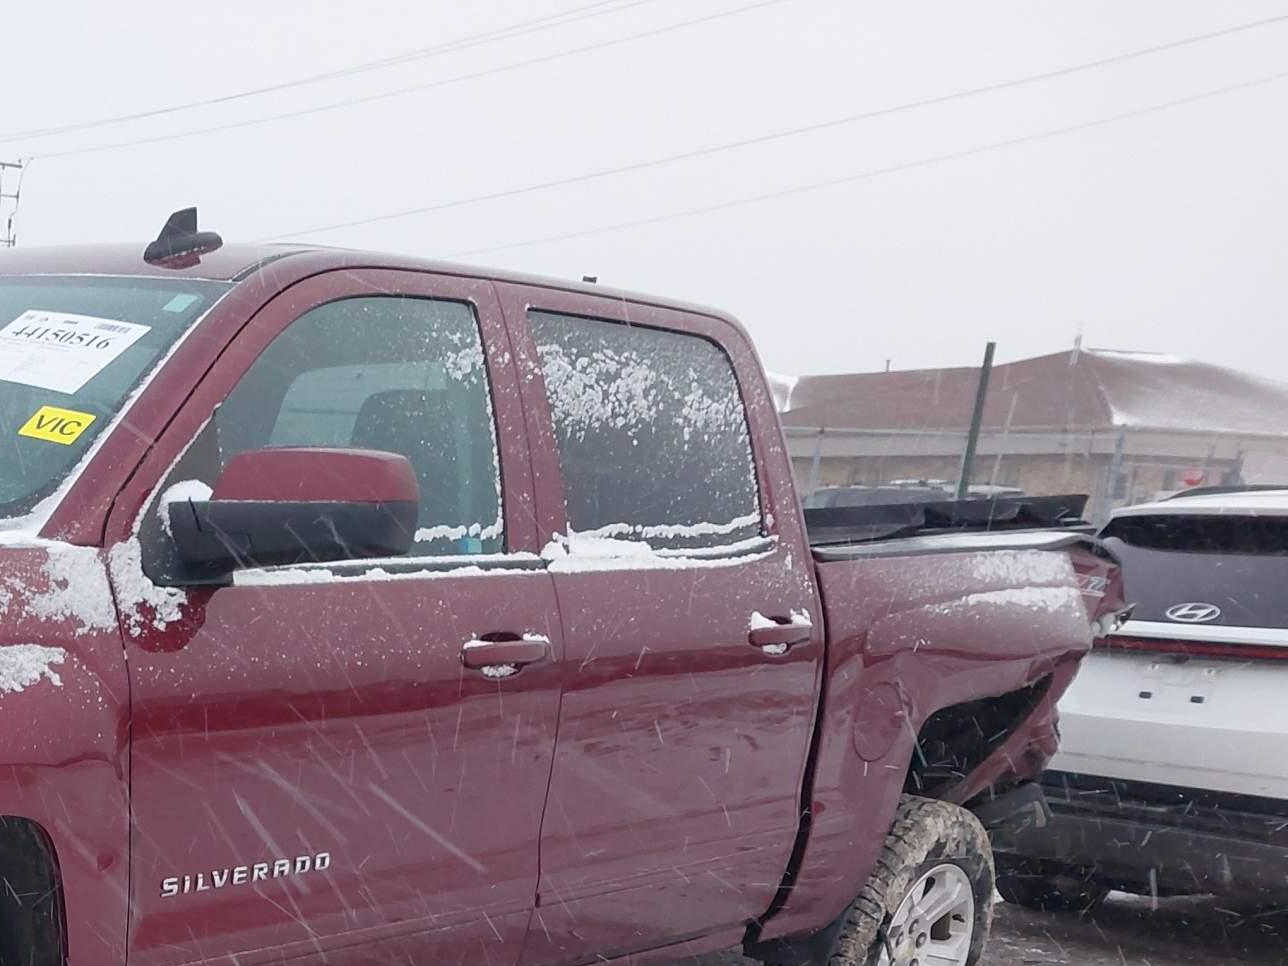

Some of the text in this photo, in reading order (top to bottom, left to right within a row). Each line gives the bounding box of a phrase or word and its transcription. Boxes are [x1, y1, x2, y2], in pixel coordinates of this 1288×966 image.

[12, 326, 112, 350] 44150516
[36, 415, 82, 436] VIC
[161, 853, 331, 897] SILVERADO
